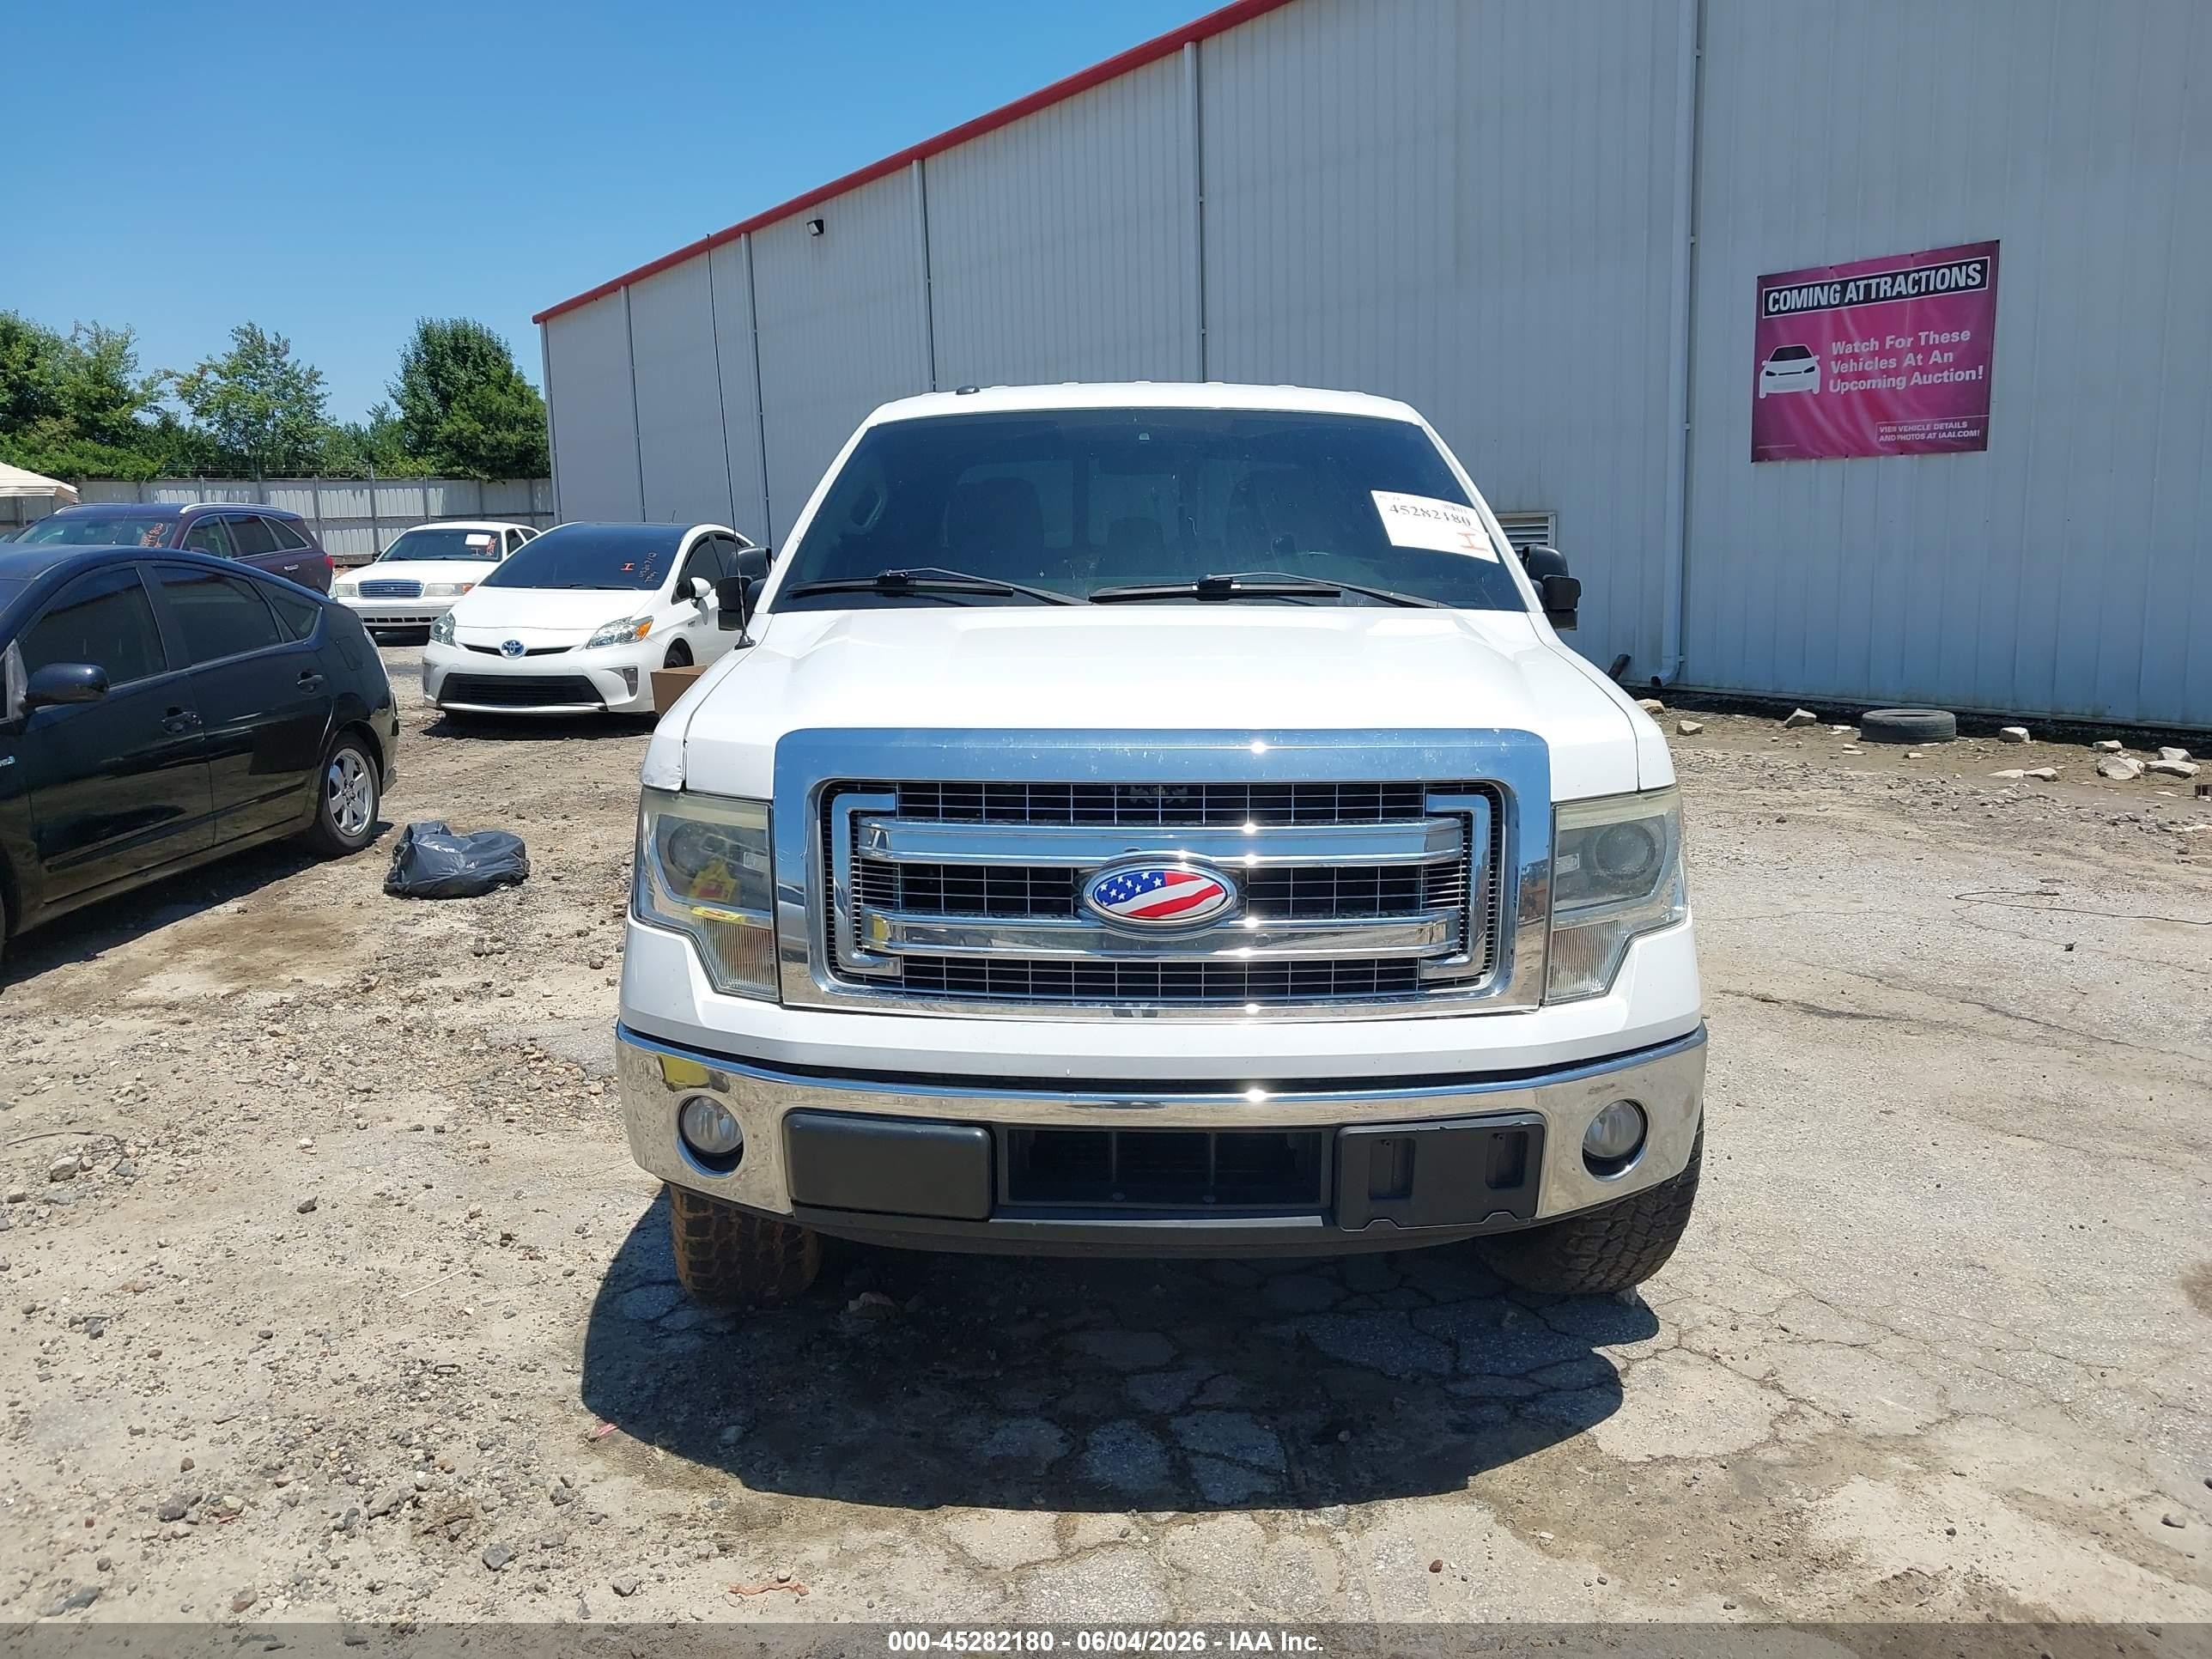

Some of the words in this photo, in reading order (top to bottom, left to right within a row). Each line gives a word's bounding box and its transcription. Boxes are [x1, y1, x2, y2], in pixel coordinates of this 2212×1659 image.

[1767, 284, 1841, 313] COMING
[1844, 263, 1982, 303] ATTRACTIONS
[1832, 337, 1879, 356] Watch
[1885, 334, 1913, 349] For
[1918, 330, 1971, 346] These
[1831, 356, 1897, 374] Vehicles
[1903, 352, 1923, 367] At
[1928, 349, 1954, 365] An
[1828, 375, 1906, 395] Upcoming
[1910, 365, 1984, 386] Auction!
[1896, 433, 1925, 441] PHOTOS
[1898, 423, 1931, 432] VEHICLE
[1933, 421, 1968, 430] DETAILS
[1389, 503, 1471, 526] 45282180
